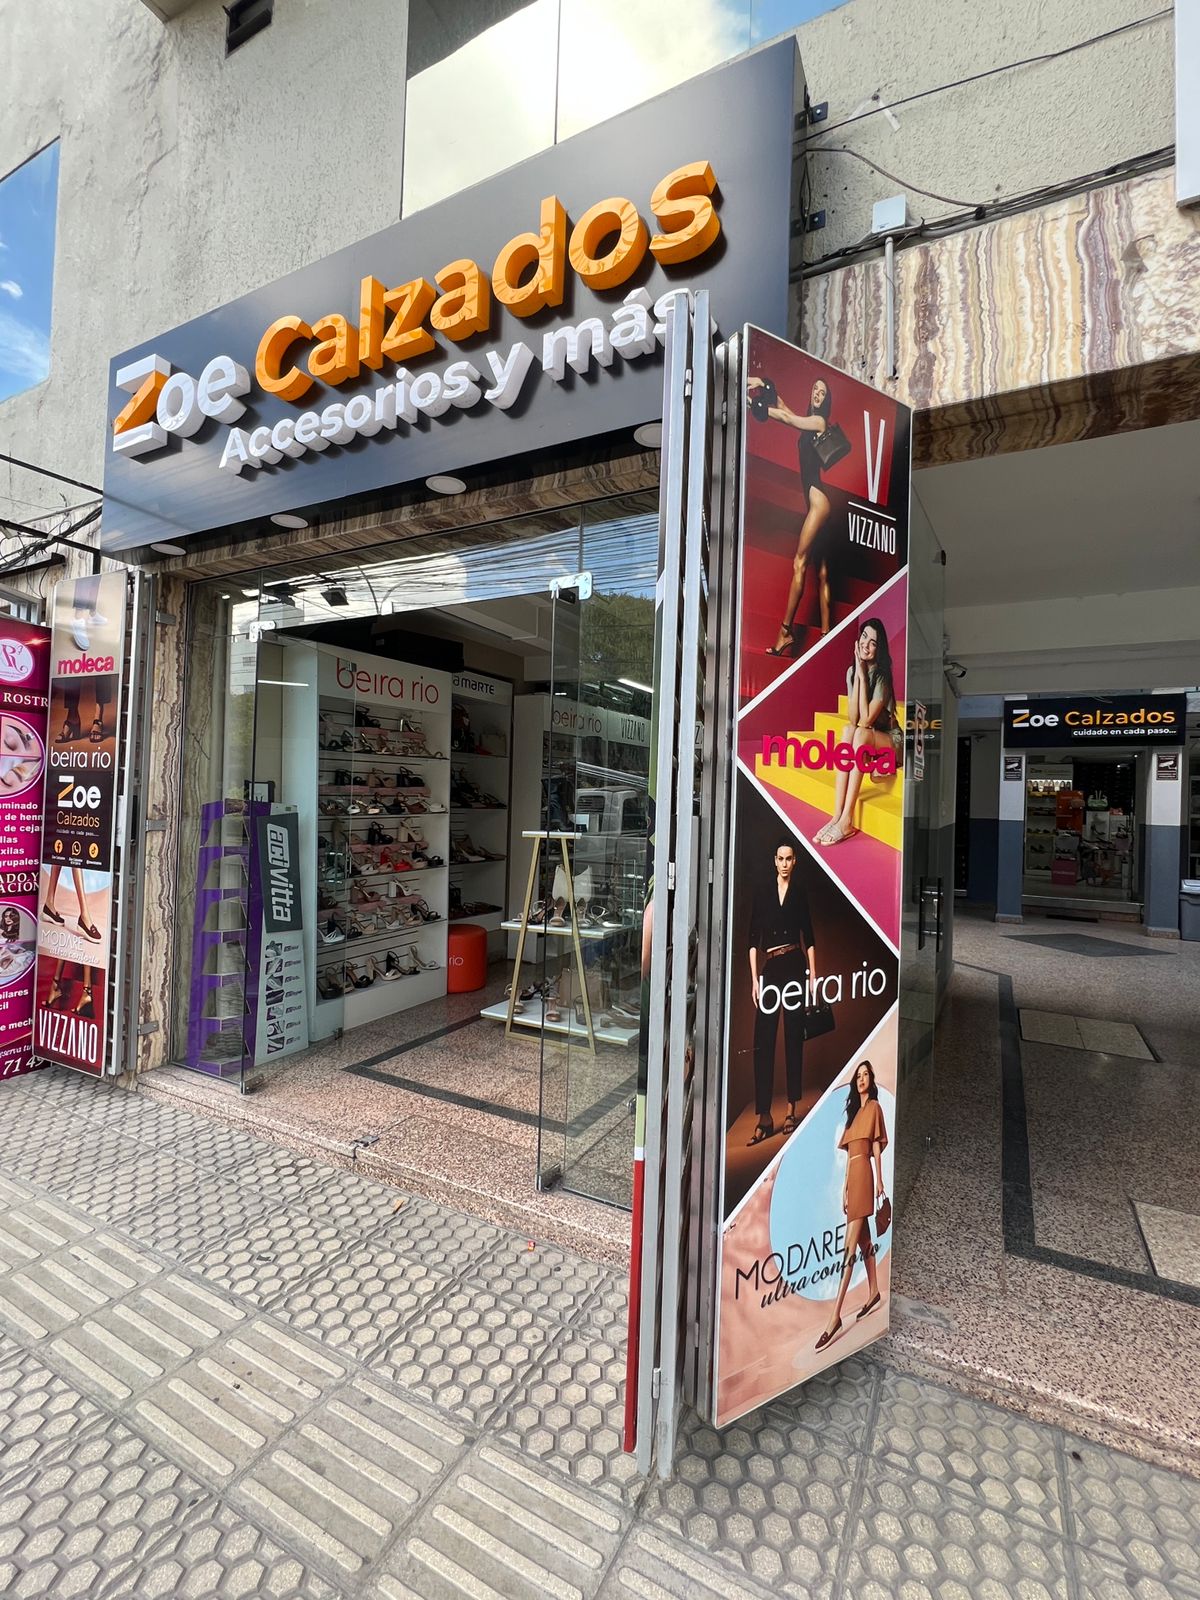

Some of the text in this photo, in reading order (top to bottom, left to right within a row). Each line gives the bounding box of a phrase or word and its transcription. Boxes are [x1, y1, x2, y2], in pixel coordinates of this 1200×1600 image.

[112, 160, 721, 458] Zoe Calzados
[219, 360, 483, 474] Accesorios
[484, 342, 532, 409] y
[848, 512, 896, 555] VIZZANO
[58, 653, 115, 675] moleca
[336, 657, 439, 704] beira rio
[1012, 709, 1175, 728] Zoe Calzados
[1124, 728, 1145, 736] cada
[50, 746, 111, 769] beira rio
[762, 730, 897, 775] moleca
[58, 775, 101, 809] Zoe
[4, 824, 16, 832] de
[5, 813, 17, 821] de
[56, 810, 100, 828] Calzados
[41, 930, 85, 952] MODARE
[758, 961, 886, 1015] beira rio
[39, 1009, 98, 1064] VIZZANO
[3, 1057, 22, 1075] 71
[735, 1223, 849, 1300] MODARE
[761, 1273, 810, 1309] ultra
